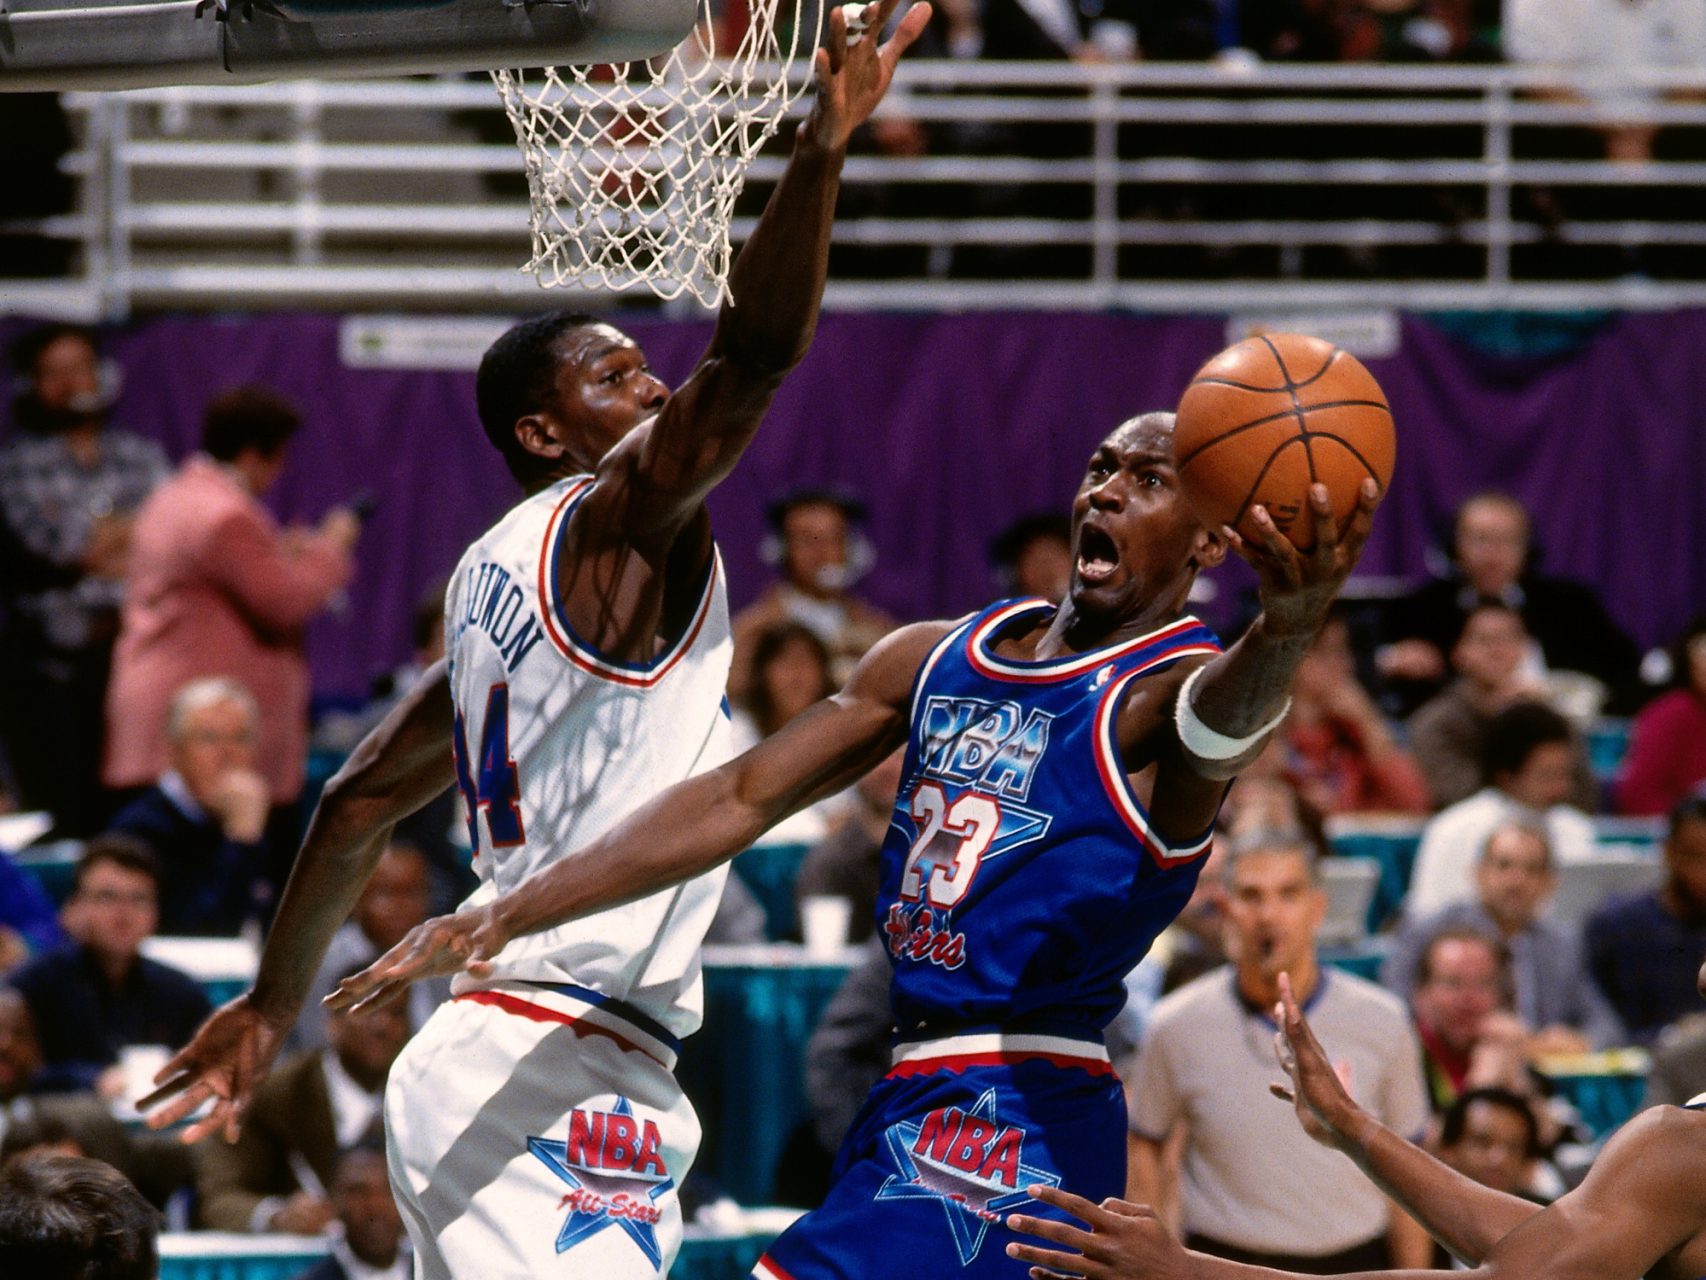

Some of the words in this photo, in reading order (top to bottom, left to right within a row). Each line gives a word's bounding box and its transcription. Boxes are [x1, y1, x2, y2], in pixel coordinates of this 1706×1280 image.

[919, 695, 1056, 803] NBA
[899, 779, 1003, 911] 23
[565, 1108, 668, 1176] NBA
[911, 1105, 1026, 1189] NBA
[556, 1187, 663, 1226] All-Stars
